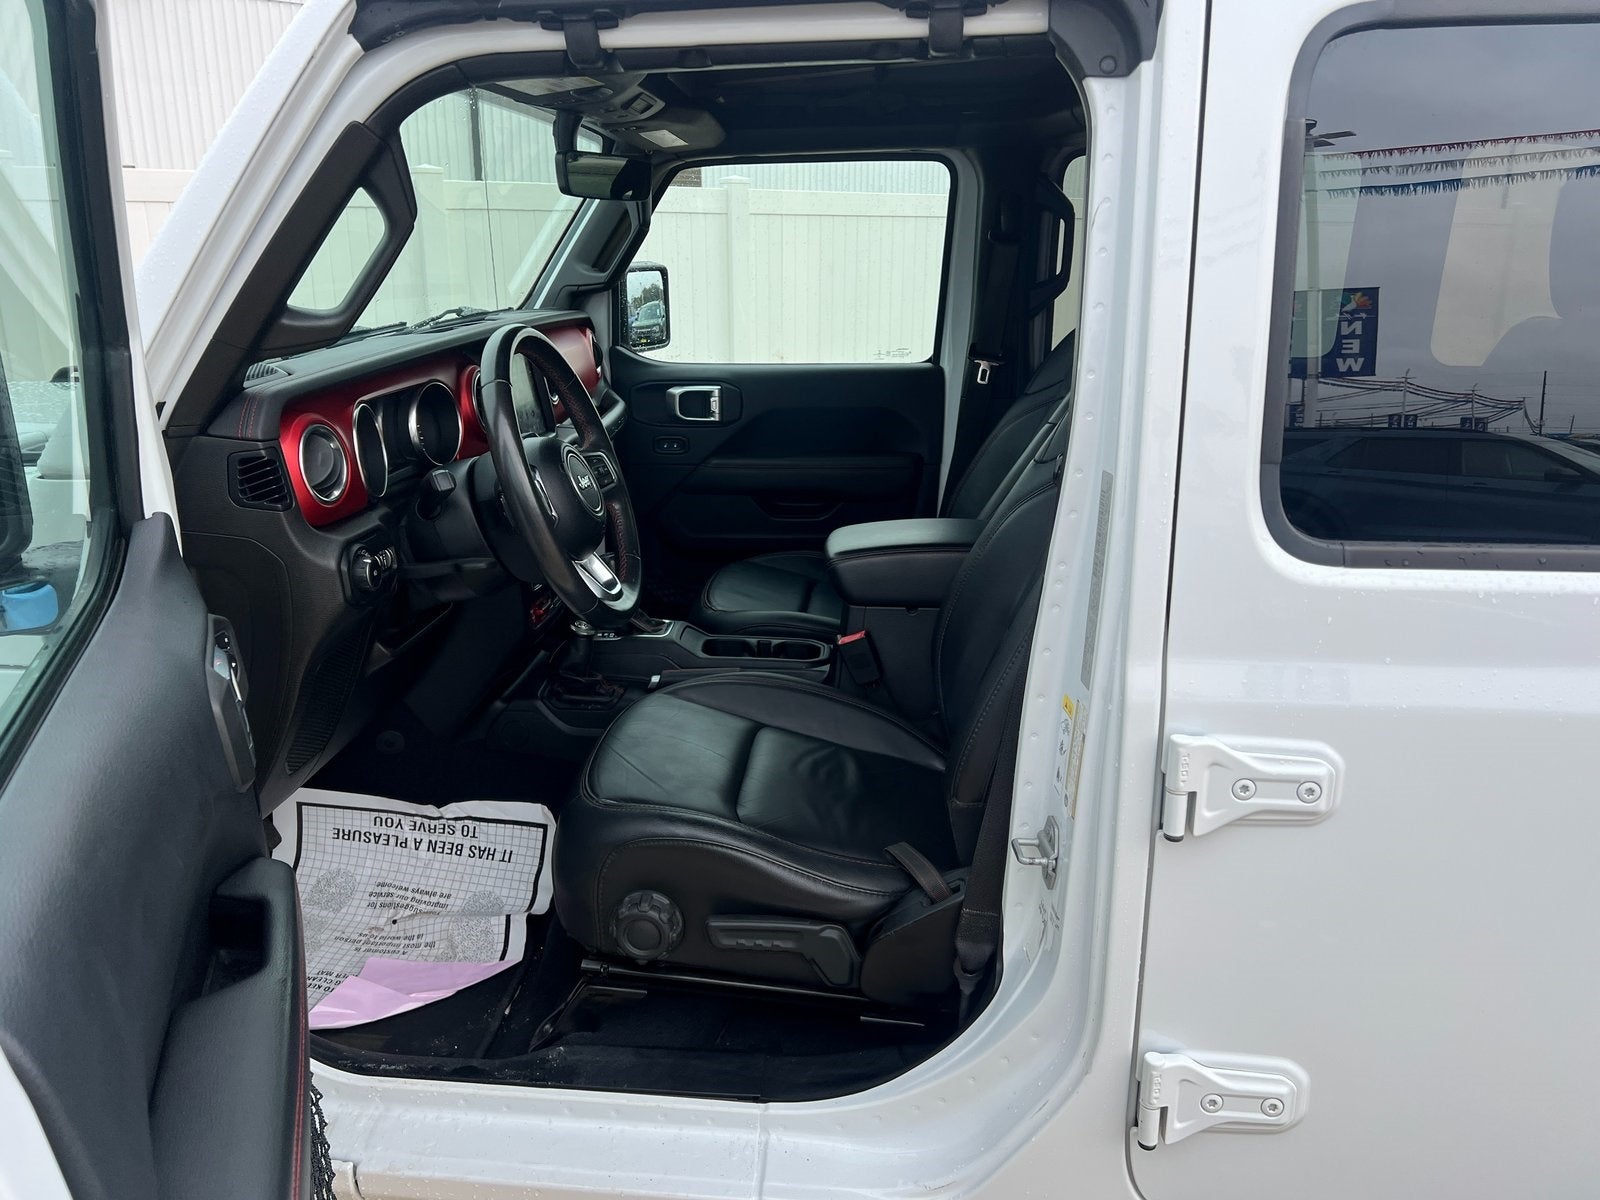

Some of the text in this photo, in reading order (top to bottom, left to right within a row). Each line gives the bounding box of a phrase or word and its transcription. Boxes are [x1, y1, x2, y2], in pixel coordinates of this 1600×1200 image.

[374, 816, 479, 839] TO SERVE YOU
[332, 827, 513, 864] IT HAS BEEN A PLEASURE
[368, 891, 394, 899] service
[410, 887, 438, 898] always
[439, 892, 452, 900] are
[367, 901, 377, 910] for
[410, 896, 448, 909] improving
[379, 901, 423, 914] suggestions
[334, 936, 362, 945] person
[361, 939, 402, 948] important
[423, 941, 436, 950] the
[363, 947, 400, 955] customer
